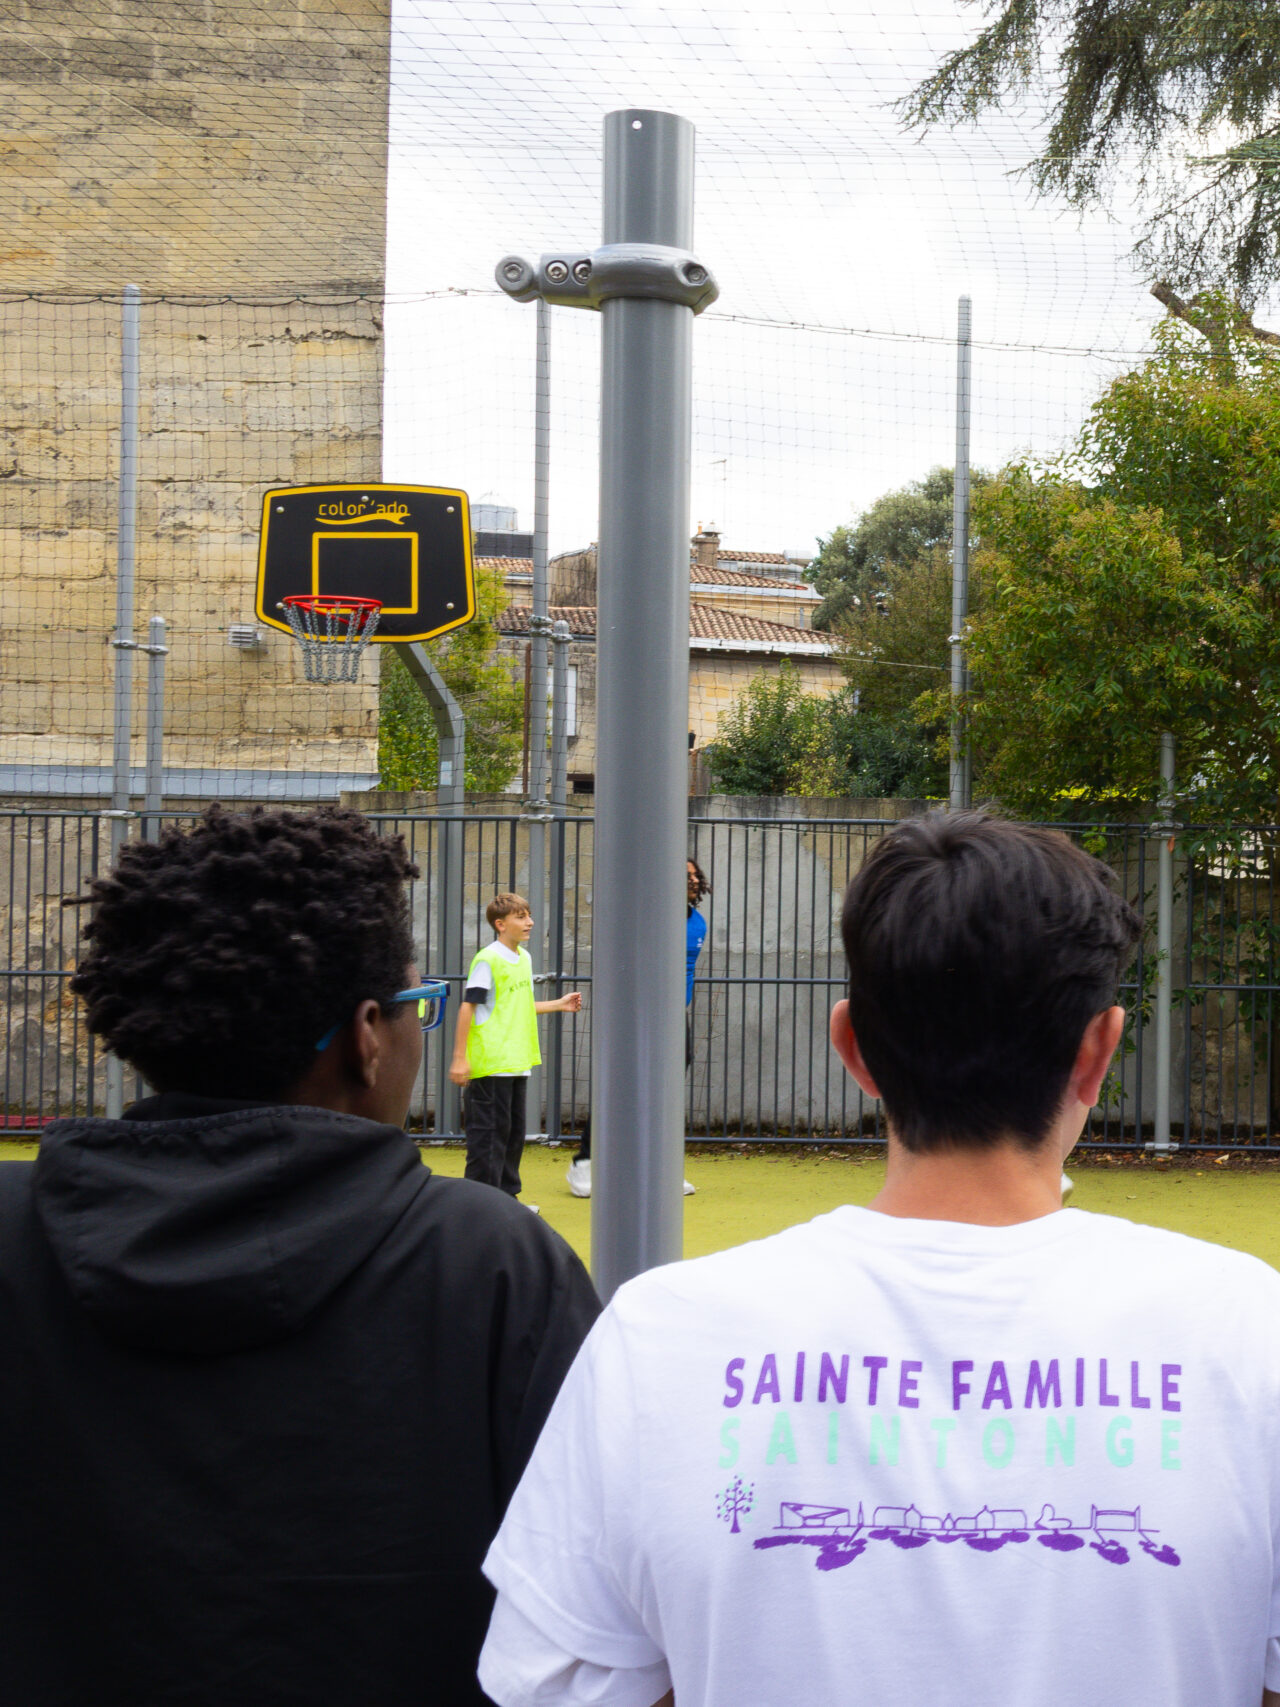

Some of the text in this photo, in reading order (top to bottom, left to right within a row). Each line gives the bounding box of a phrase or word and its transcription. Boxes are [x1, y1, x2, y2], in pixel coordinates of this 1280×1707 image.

[723, 1351, 1182, 1412] SAINTE FAMILLE
[718, 1411, 1182, 1470] SAINTONGE
